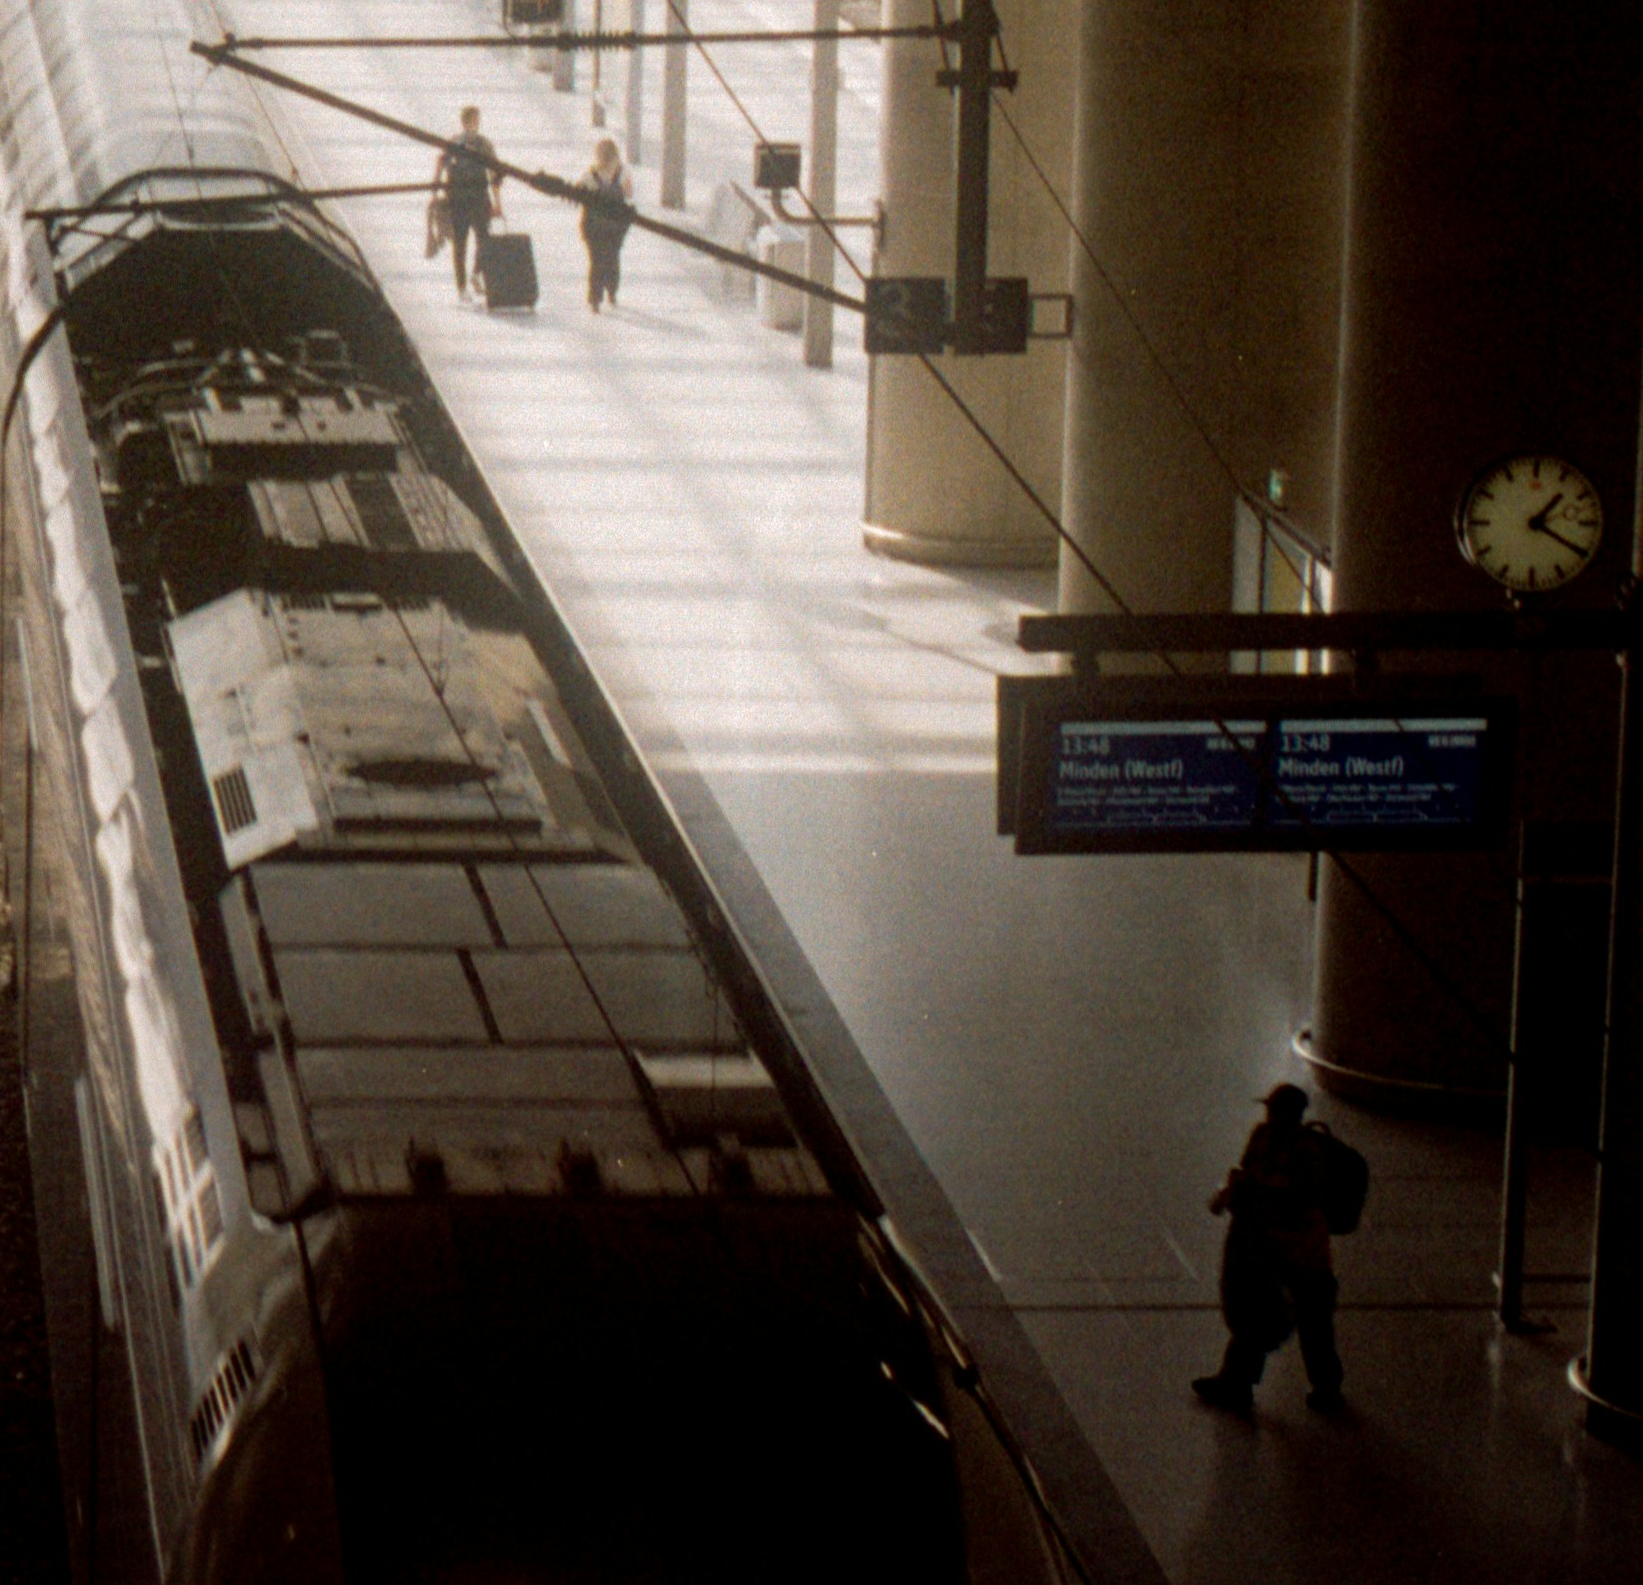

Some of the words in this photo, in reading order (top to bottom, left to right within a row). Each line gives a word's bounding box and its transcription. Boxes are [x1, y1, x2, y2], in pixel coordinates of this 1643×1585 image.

[1281, 733, 1331, 752] 13:48
[1059, 760, 1120, 779] Minden
[1124, 758, 1183, 781] (Westf)
[1278, 757, 1340, 777] Minden
[1344, 755, 1404, 778] (Westf)
